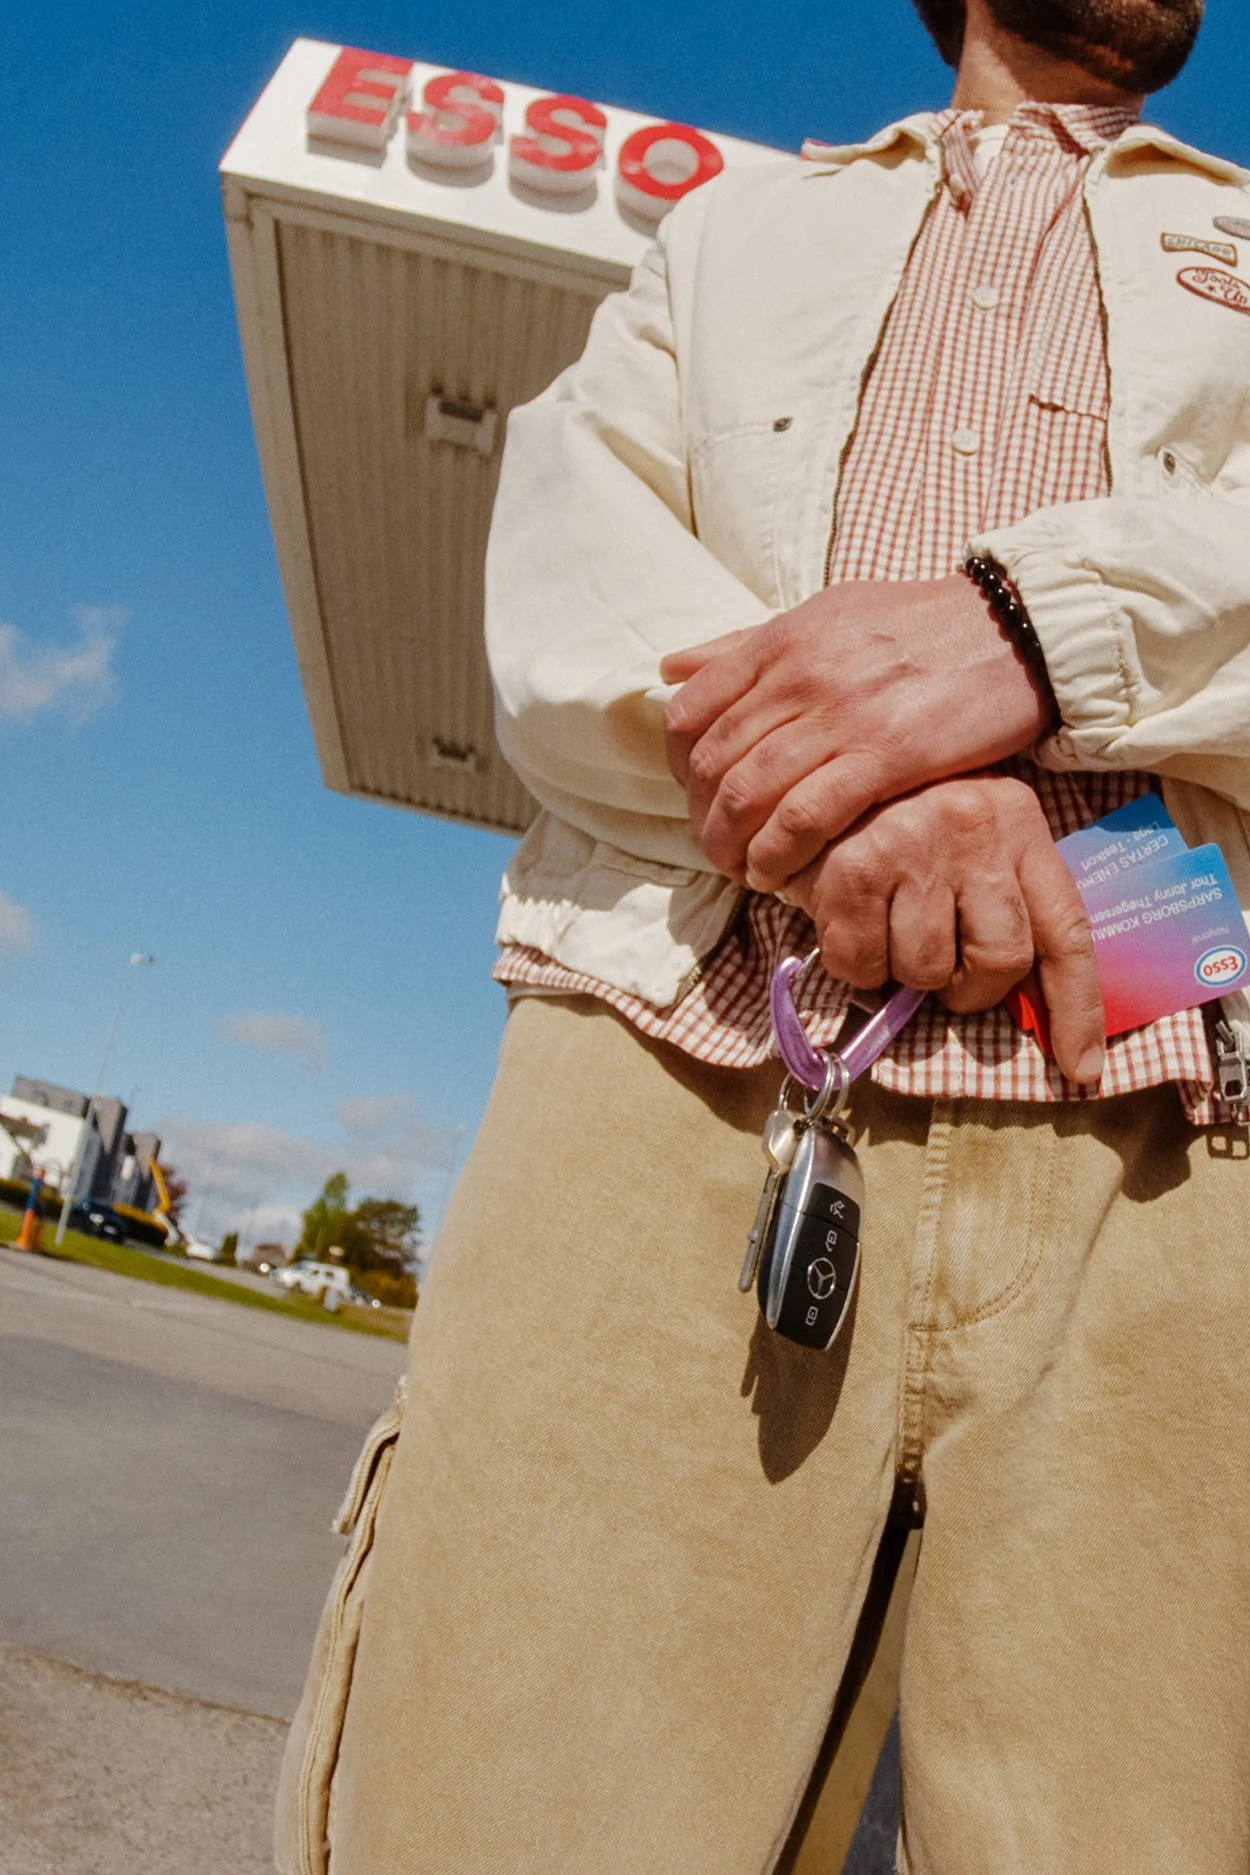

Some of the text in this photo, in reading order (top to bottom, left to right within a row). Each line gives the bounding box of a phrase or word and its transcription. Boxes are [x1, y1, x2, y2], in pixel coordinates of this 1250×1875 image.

[306, 45, 724, 205] ESSO
[1120, 834, 1169, 869] CERTAS
[1091, 874, 1218, 923] Thor Jonny Thøgersen
[1143, 887, 1223, 924] SARPSBORG
